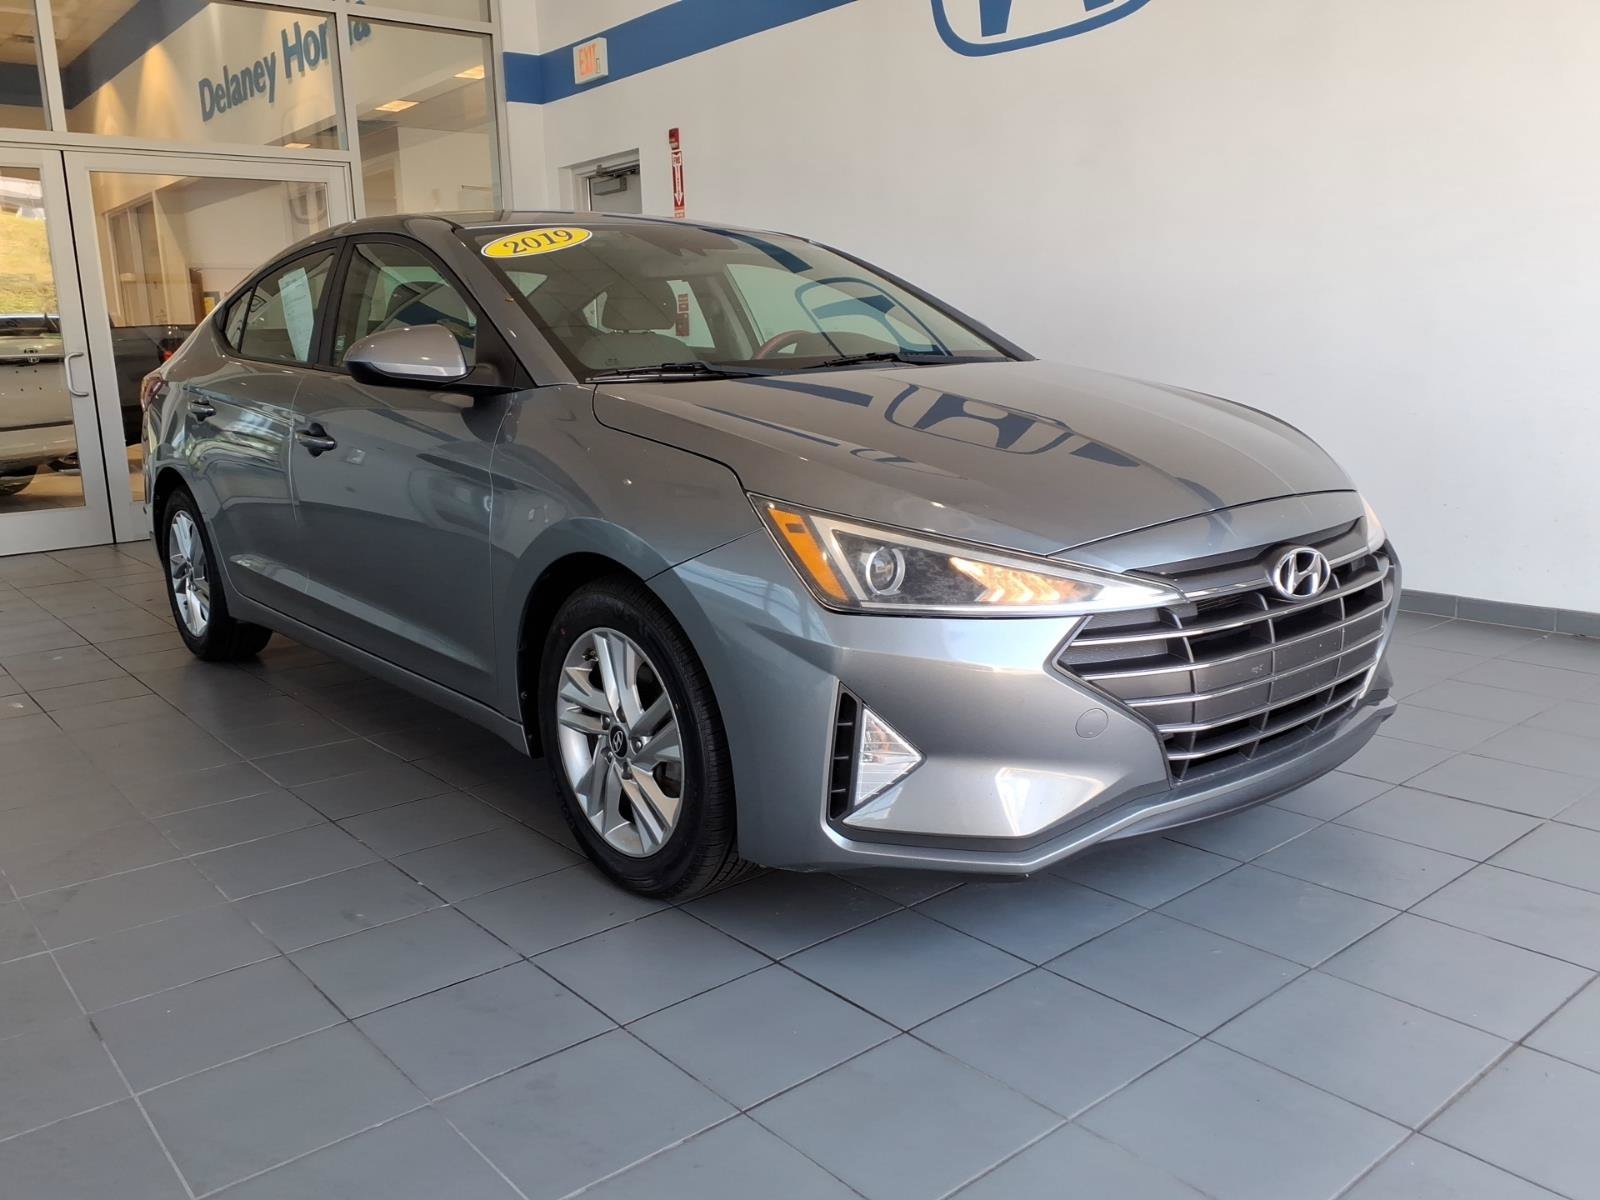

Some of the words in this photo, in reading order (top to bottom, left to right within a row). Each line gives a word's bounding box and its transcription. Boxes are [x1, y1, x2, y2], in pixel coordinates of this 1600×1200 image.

[199, 52, 276, 122] Delaney
[281, 2, 371, 79] Hona
[578, 43, 598, 77] EXIT
[503, 229, 573, 254] 2019
